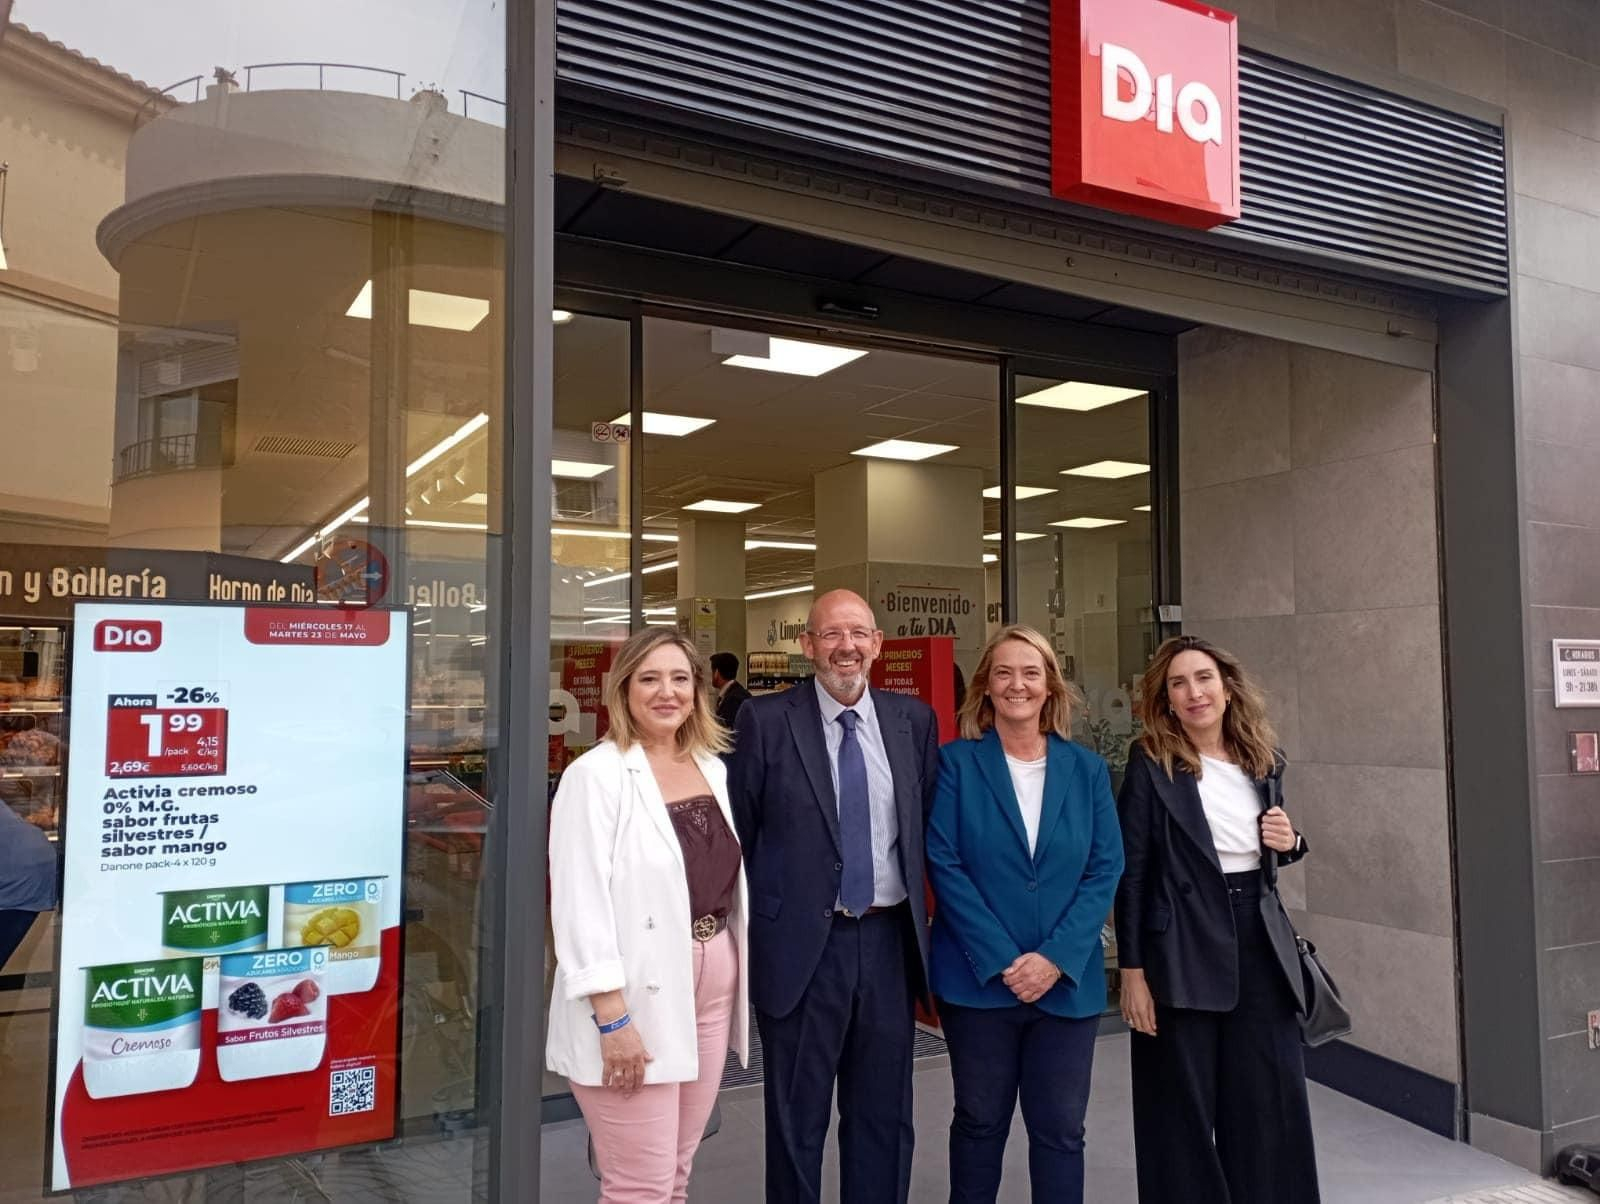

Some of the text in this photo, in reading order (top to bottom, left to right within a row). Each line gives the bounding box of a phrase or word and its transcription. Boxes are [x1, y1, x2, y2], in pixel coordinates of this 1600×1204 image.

[24, 571, 41, 603] y
[52, 567, 167, 598] Bollería
[267, 579, 286, 601] de
[886, 591, 970, 615] Bienvenido
[269, 622, 286, 631] DEL
[344, 623, 353, 631] 17
[355, 624, 366, 632] AL
[897, 617, 956, 636] a tu DIA
[269, 631, 367, 640] MARTES 23 DE MAYO
[894, 678, 914, 686] TODAS
[113, 697, 153, 707] Ahora
[166, 687, 220, 704] -26%
[140, 713, 203, 757] 1 99
[197, 736, 219, 748] 4,15
[164, 747, 189, 757] /pack
[197, 747, 218, 757] €/kg
[110, 761, 150, 775] 2,69€
[103, 784, 258, 800] Activia cremoso
[103, 799, 180, 815] 0% M.G.
[102, 813, 219, 829] sabor frutas
[101, 824, 209, 843] silvestres /
[100, 841, 227, 858] sabor mango
[100, 862, 143, 872] Danone
[191, 857, 207, 867] 120
[208, 858, 217, 867] g
[312, 882, 358, 898] ZERO
[168, 899, 261, 925] ACTIVIA
[252, 951, 303, 969] ZERO
[92, 972, 194, 1003] ACTIVIA
[225, 1024, 323, 1044] Sabor Frutos Silvestres
[111, 1037, 172, 1055] Cremoso
